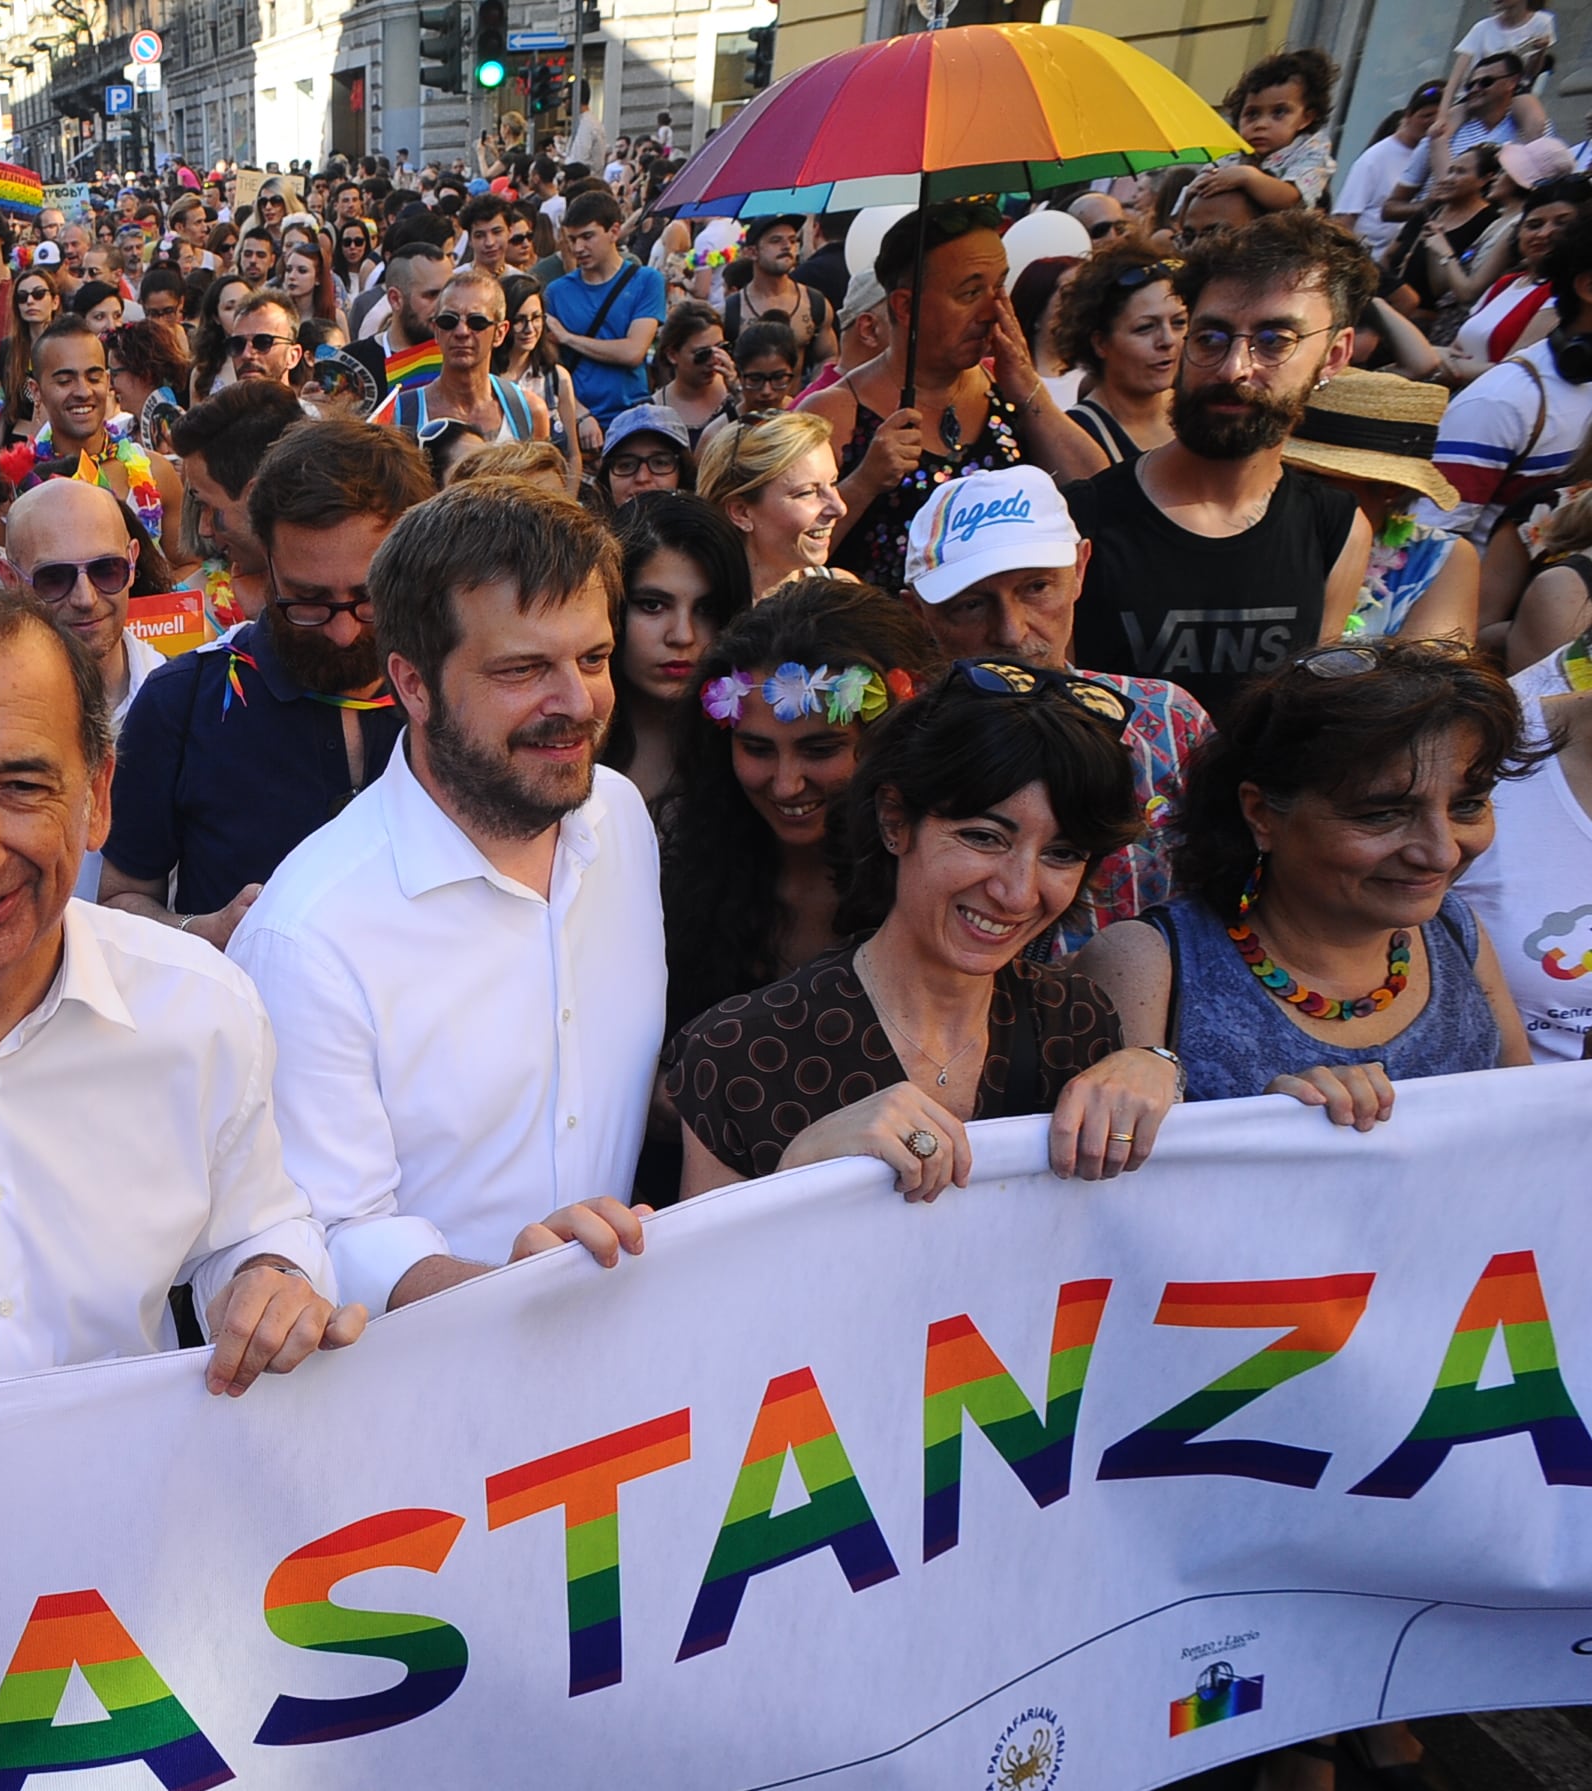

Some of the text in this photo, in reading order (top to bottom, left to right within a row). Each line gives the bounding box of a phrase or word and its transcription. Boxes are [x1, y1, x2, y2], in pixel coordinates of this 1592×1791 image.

[111, 88, 128, 112] P
[951, 489, 1032, 542] agedo
[127, 615, 184, 638] thwell
[1120, 606, 1298, 674] VANS
